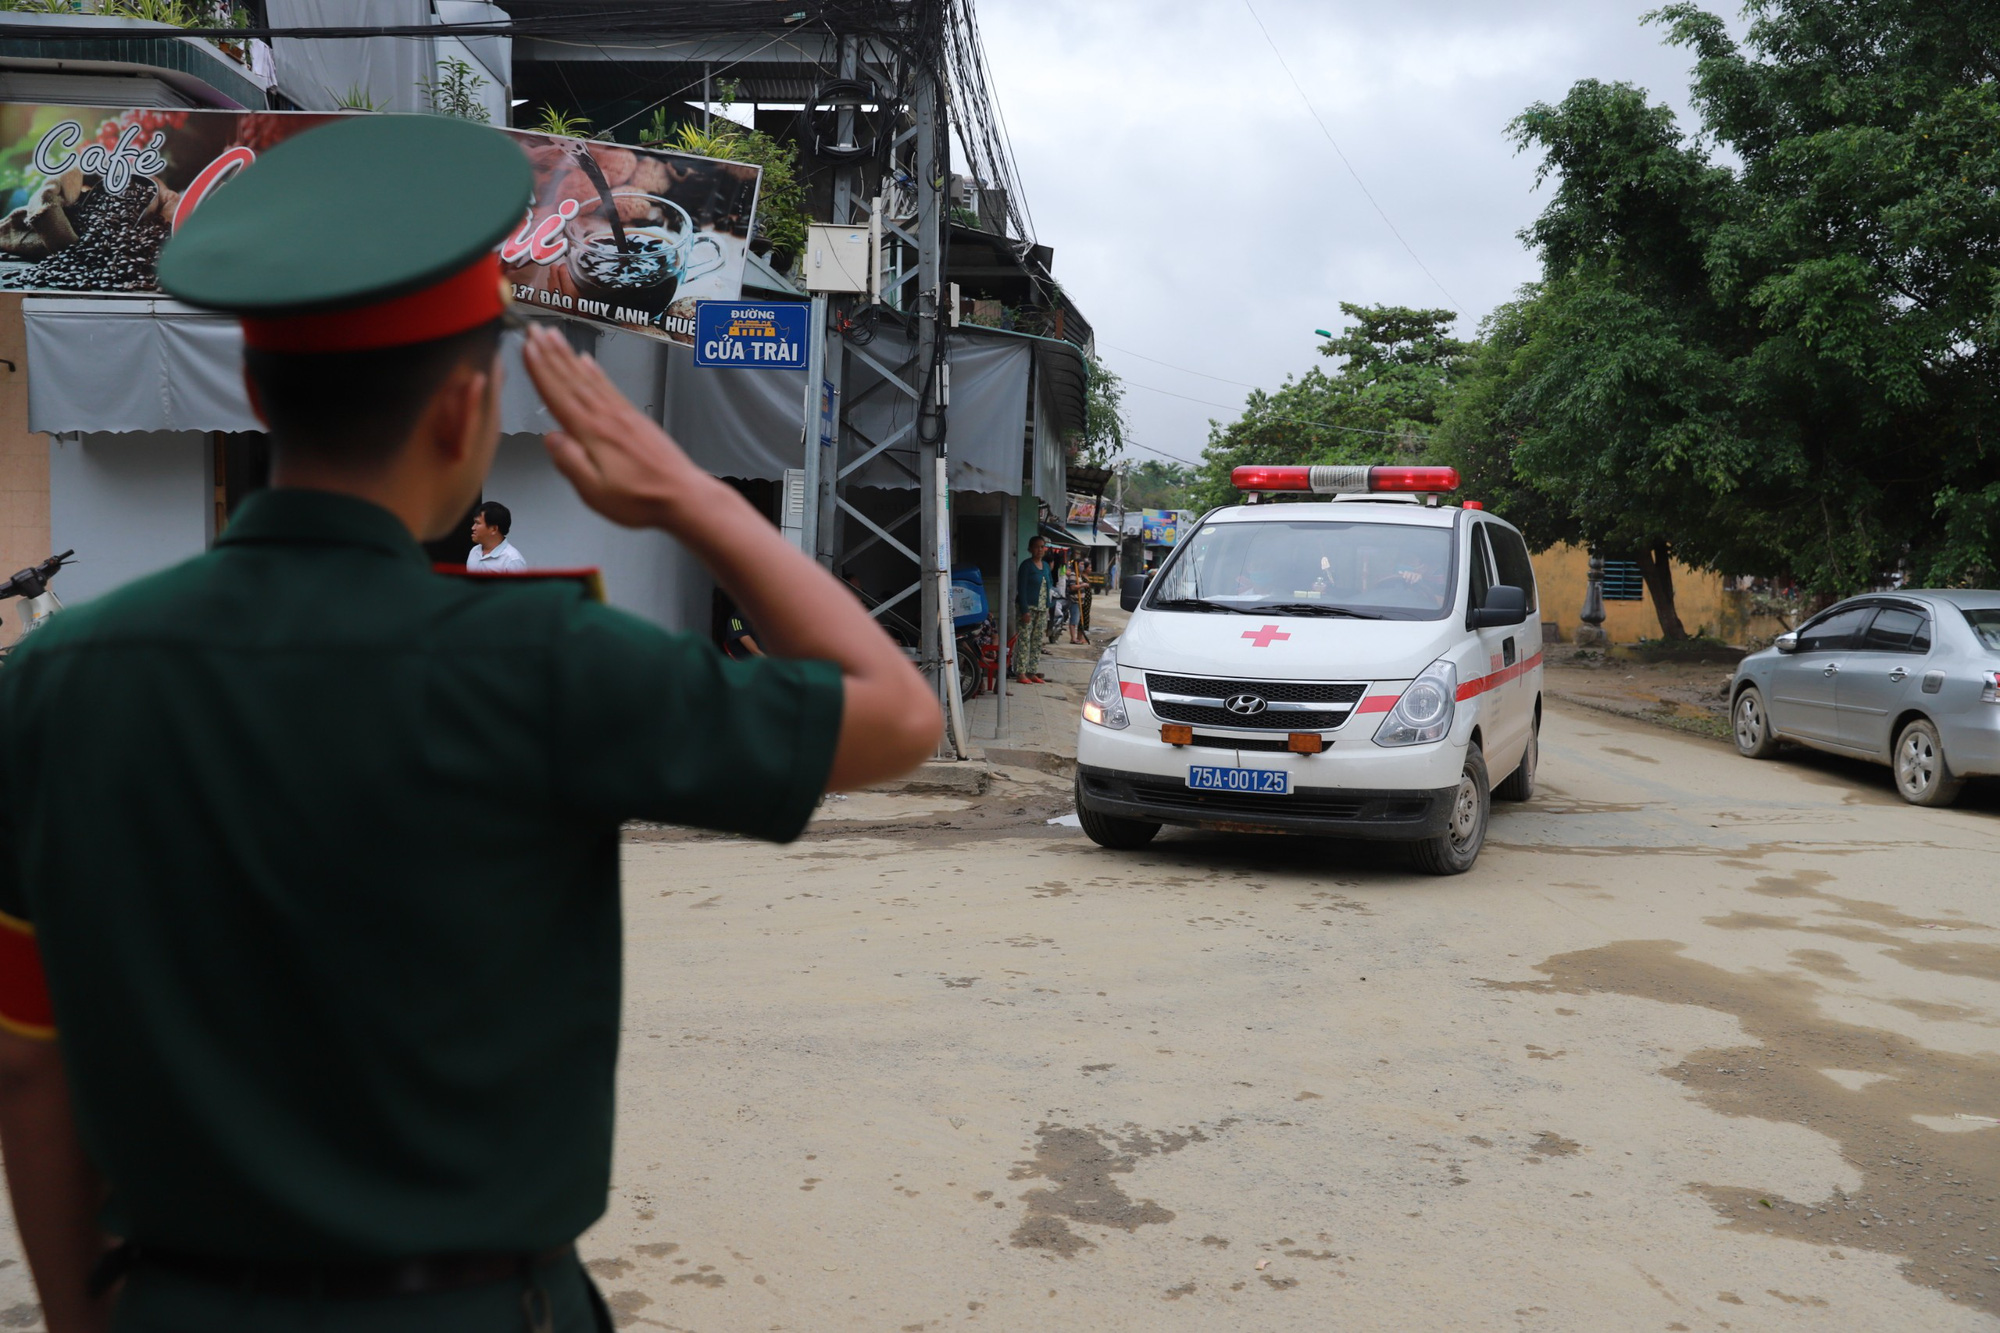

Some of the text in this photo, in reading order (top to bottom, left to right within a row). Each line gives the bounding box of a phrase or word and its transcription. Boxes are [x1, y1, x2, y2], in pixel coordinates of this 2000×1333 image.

[35, 121, 166, 194] Café
[540, 289, 573, 309] ĐÀO
[577, 298, 611, 318] DUY
[614, 305, 649, 327] ANH
[730, 308, 776, 320] ĐƯỜNG
[704, 334, 798, 362] CỬA TRÀI
[1192, 767, 1285, 792] 75A-001.25
